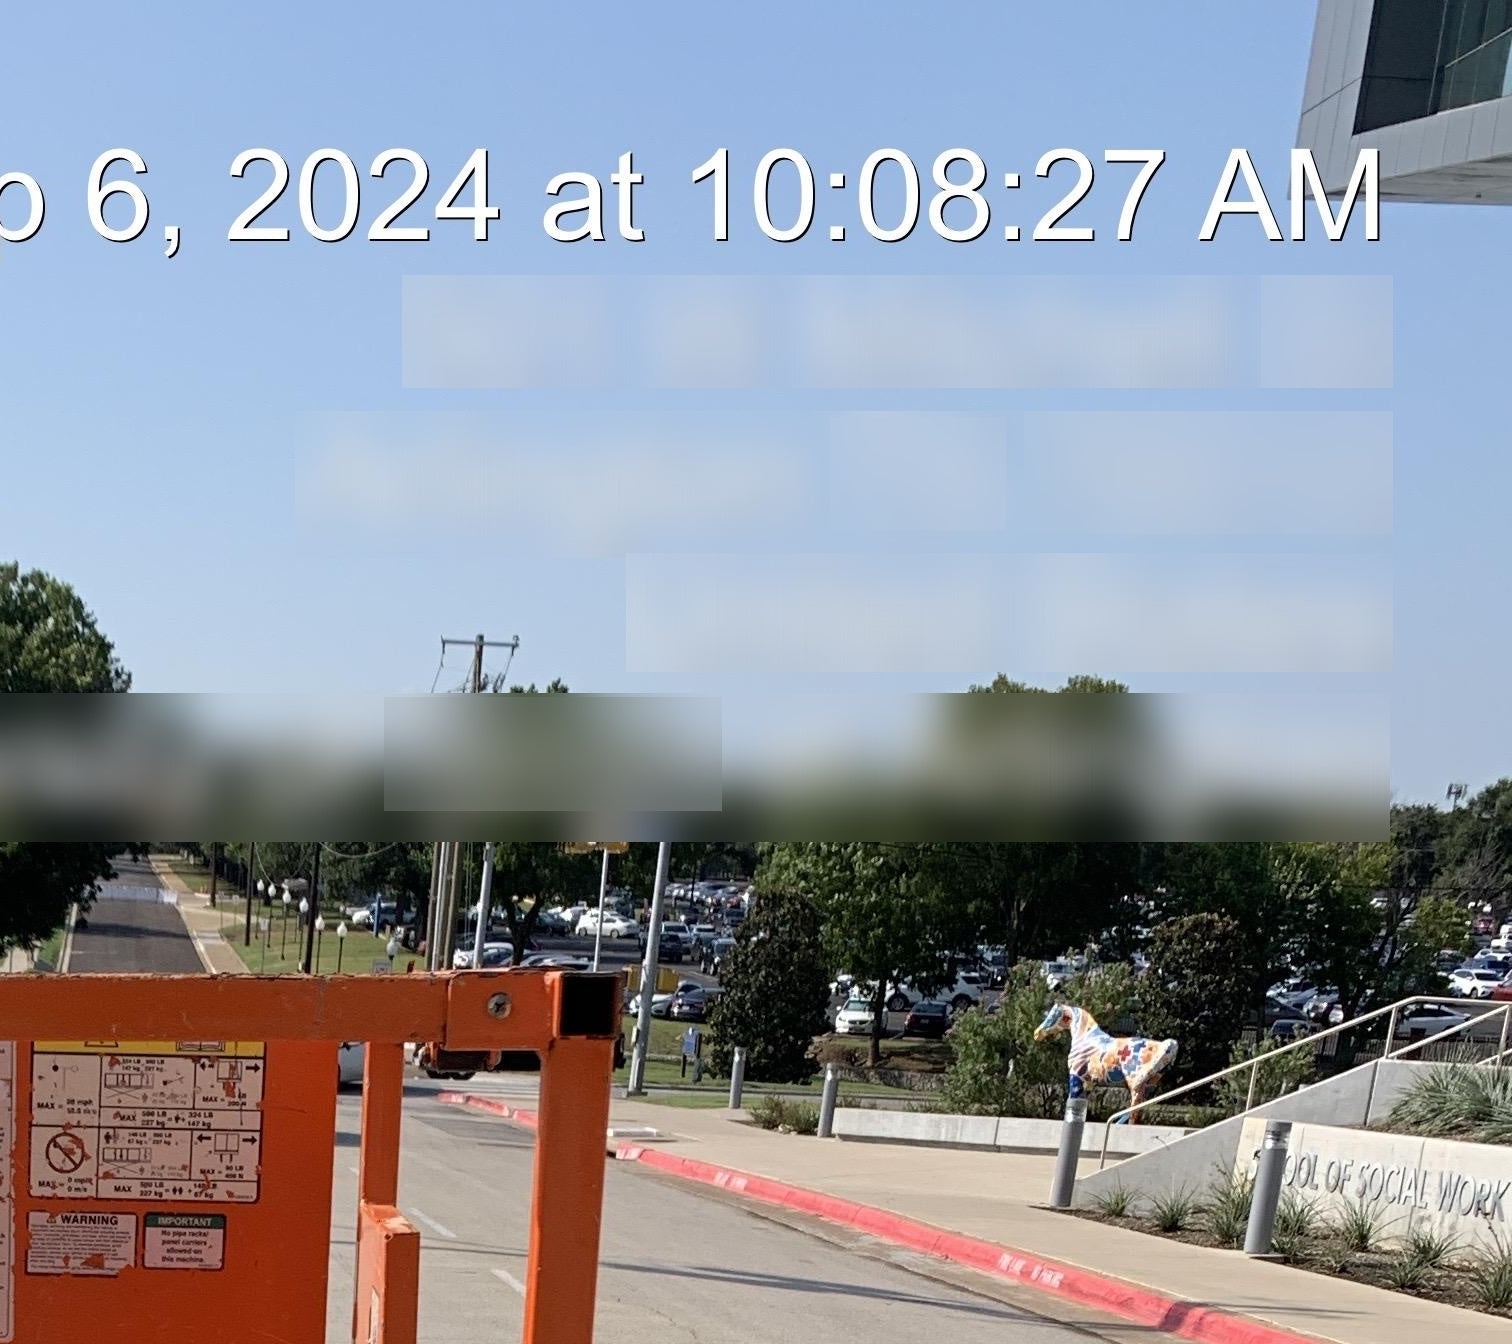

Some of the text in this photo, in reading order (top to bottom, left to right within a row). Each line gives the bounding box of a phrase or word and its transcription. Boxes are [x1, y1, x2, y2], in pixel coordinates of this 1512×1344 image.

[202, 1121, 211, 1129] kg
[1325, 1158, 1354, 1194] OF
[1358, 1160, 1428, 1209] SOCIAL
[1439, 1169, 1511, 1222] WORK
[61, 1215, 118, 1226] WARNING
[157, 1217, 213, 1227] IMPORTANT
[172, 1230, 187, 1238] pipe
